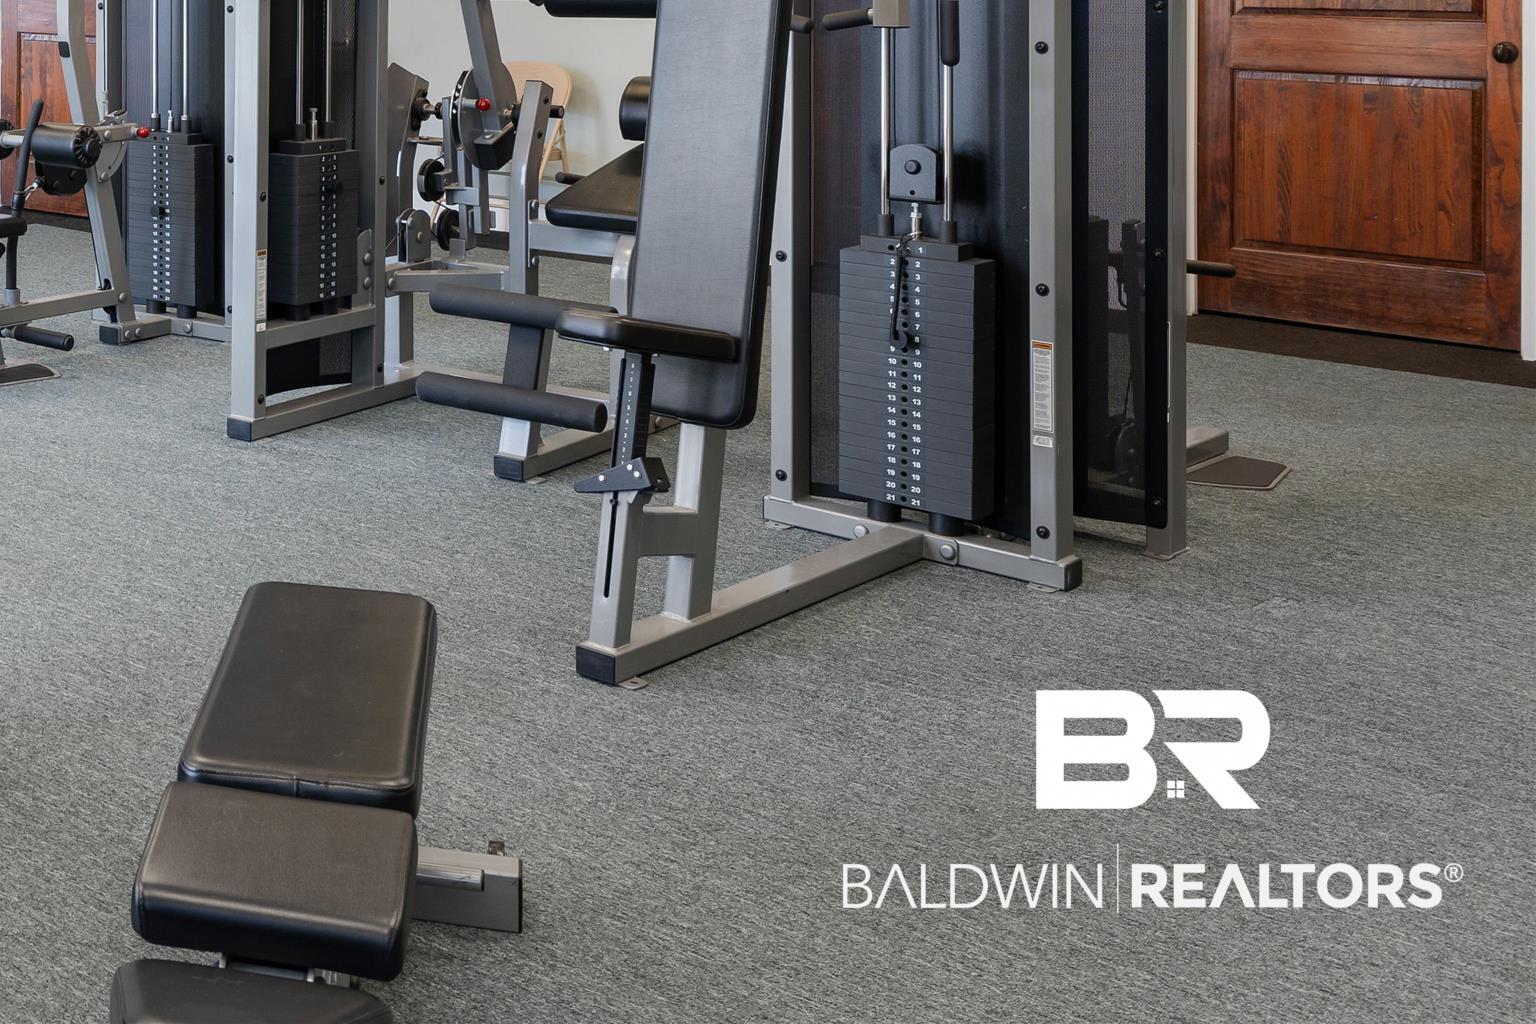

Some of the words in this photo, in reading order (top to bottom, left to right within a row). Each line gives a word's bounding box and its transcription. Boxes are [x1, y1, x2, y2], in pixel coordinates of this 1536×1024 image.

[887, 357, 897, 365] 10
[912, 361, 922, 369] 10
[913, 373, 922, 381] 11
[887, 381, 897, 389] 12
[912, 385, 922, 393] 12
[887, 394, 897, 402] 13
[912, 398, 922, 406] 13
[887, 406, 897, 414] 14
[911, 410, 921, 418] 14
[887, 418, 897, 426] 15
[912, 423, 922, 431] 15
[887, 431, 896, 439] 16
[911, 435, 921, 444] 16
[886, 443, 896, 451] 17
[911, 448, 921, 456] 17
[887, 456, 897, 464] 18
[911, 461, 921, 469] 18
[886, 468, 896, 476] 19
[911, 473, 921, 481] 19
[885, 480, 896, 489] 20
[910, 485, 921, 494] 20
[886, 493, 896, 501] 21
[911, 498, 921, 507] 21
